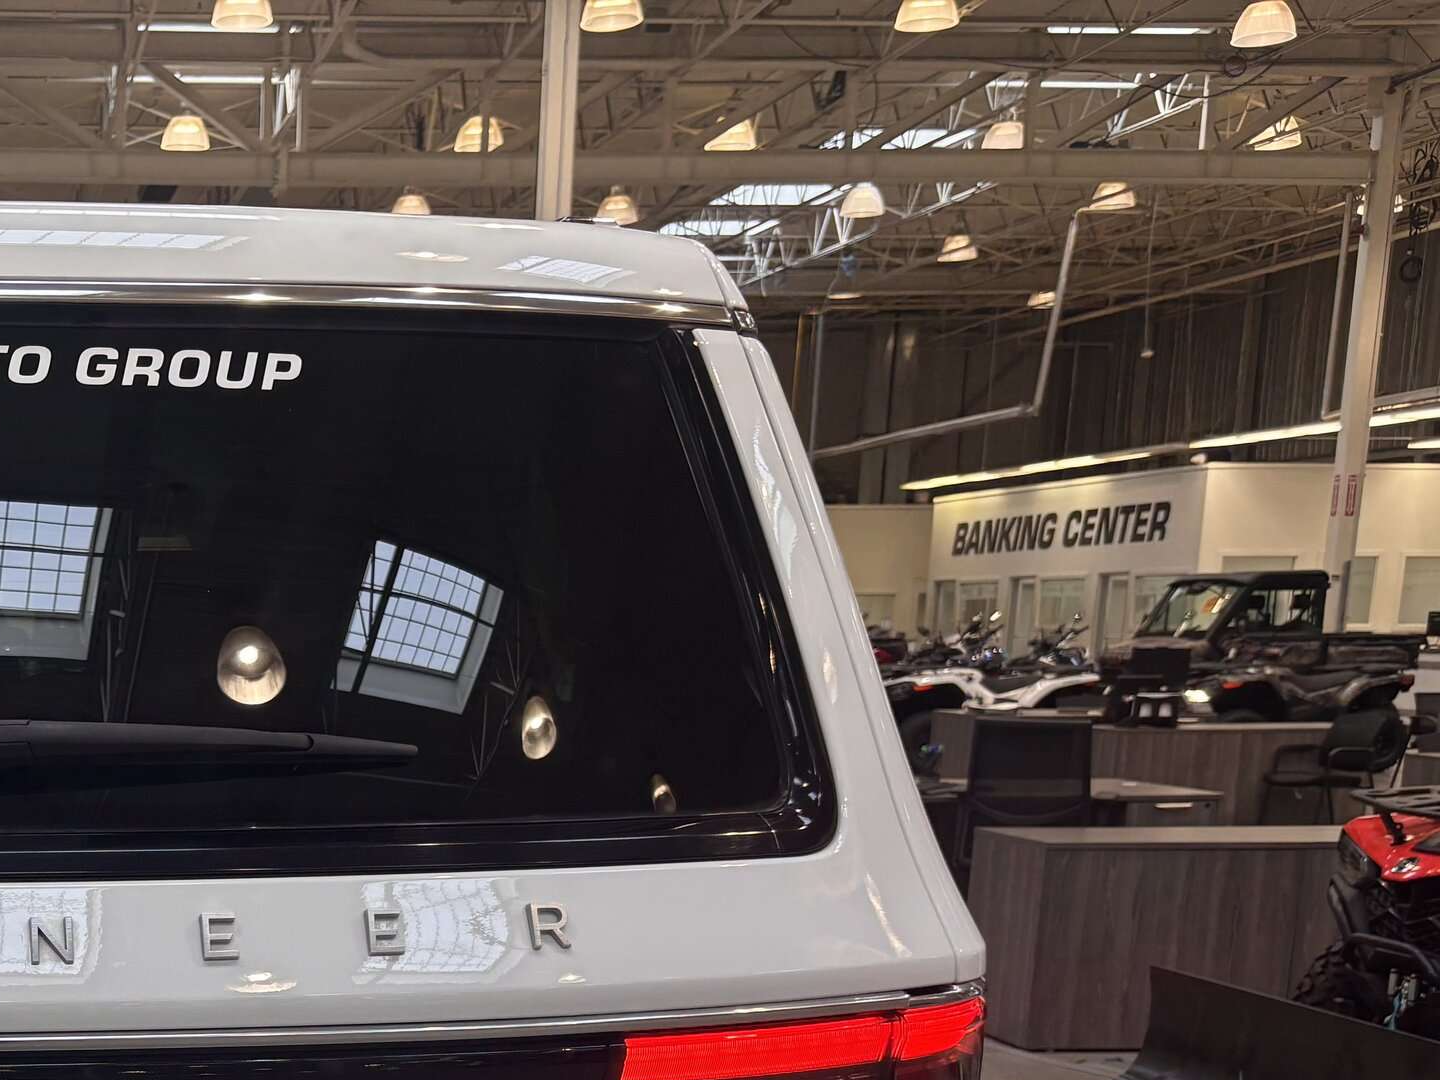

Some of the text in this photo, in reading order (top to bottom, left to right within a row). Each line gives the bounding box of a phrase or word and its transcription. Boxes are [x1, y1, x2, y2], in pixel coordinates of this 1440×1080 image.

[75, 346, 303, 391] GROUP
[951, 501, 1172, 557] BANKING CENTER
